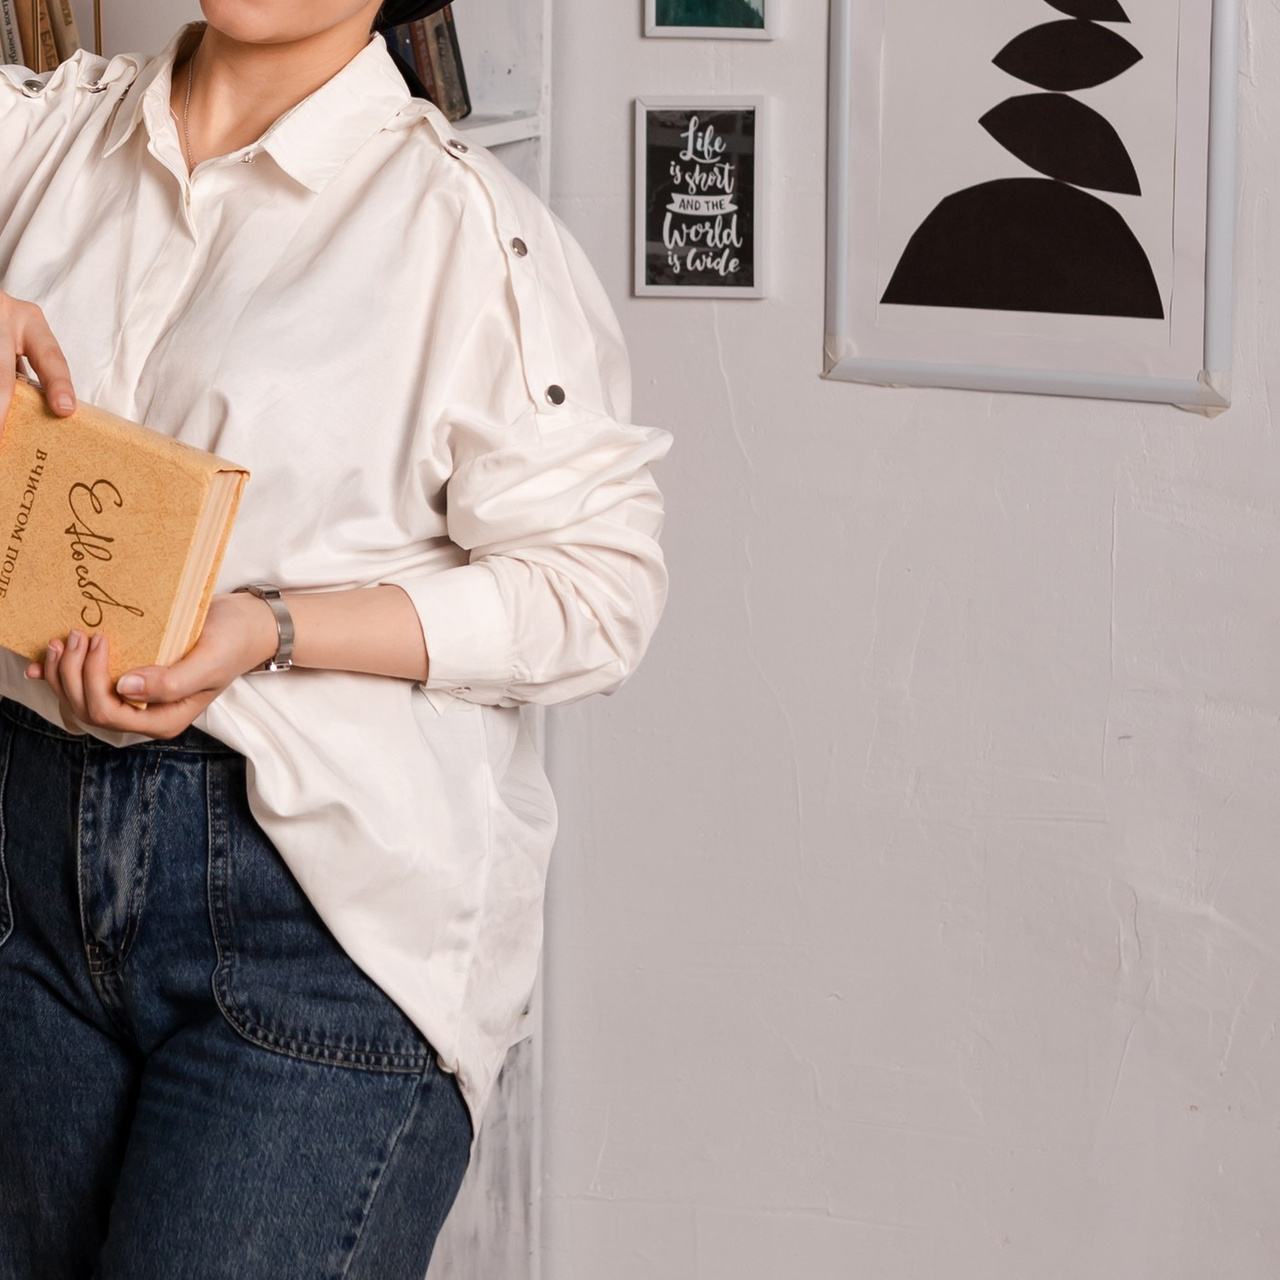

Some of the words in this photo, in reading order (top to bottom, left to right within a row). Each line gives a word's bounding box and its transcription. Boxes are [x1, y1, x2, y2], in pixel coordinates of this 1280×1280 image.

[679, 116, 727, 163] Life
[670, 161, 681, 185] is
[685, 163, 736, 195] short
[679, 199, 701, 211] AND
[705, 199, 726, 211] THE
[667, 251, 681, 274] is
[12, 464, 44, 543] ЧИСТОМ
